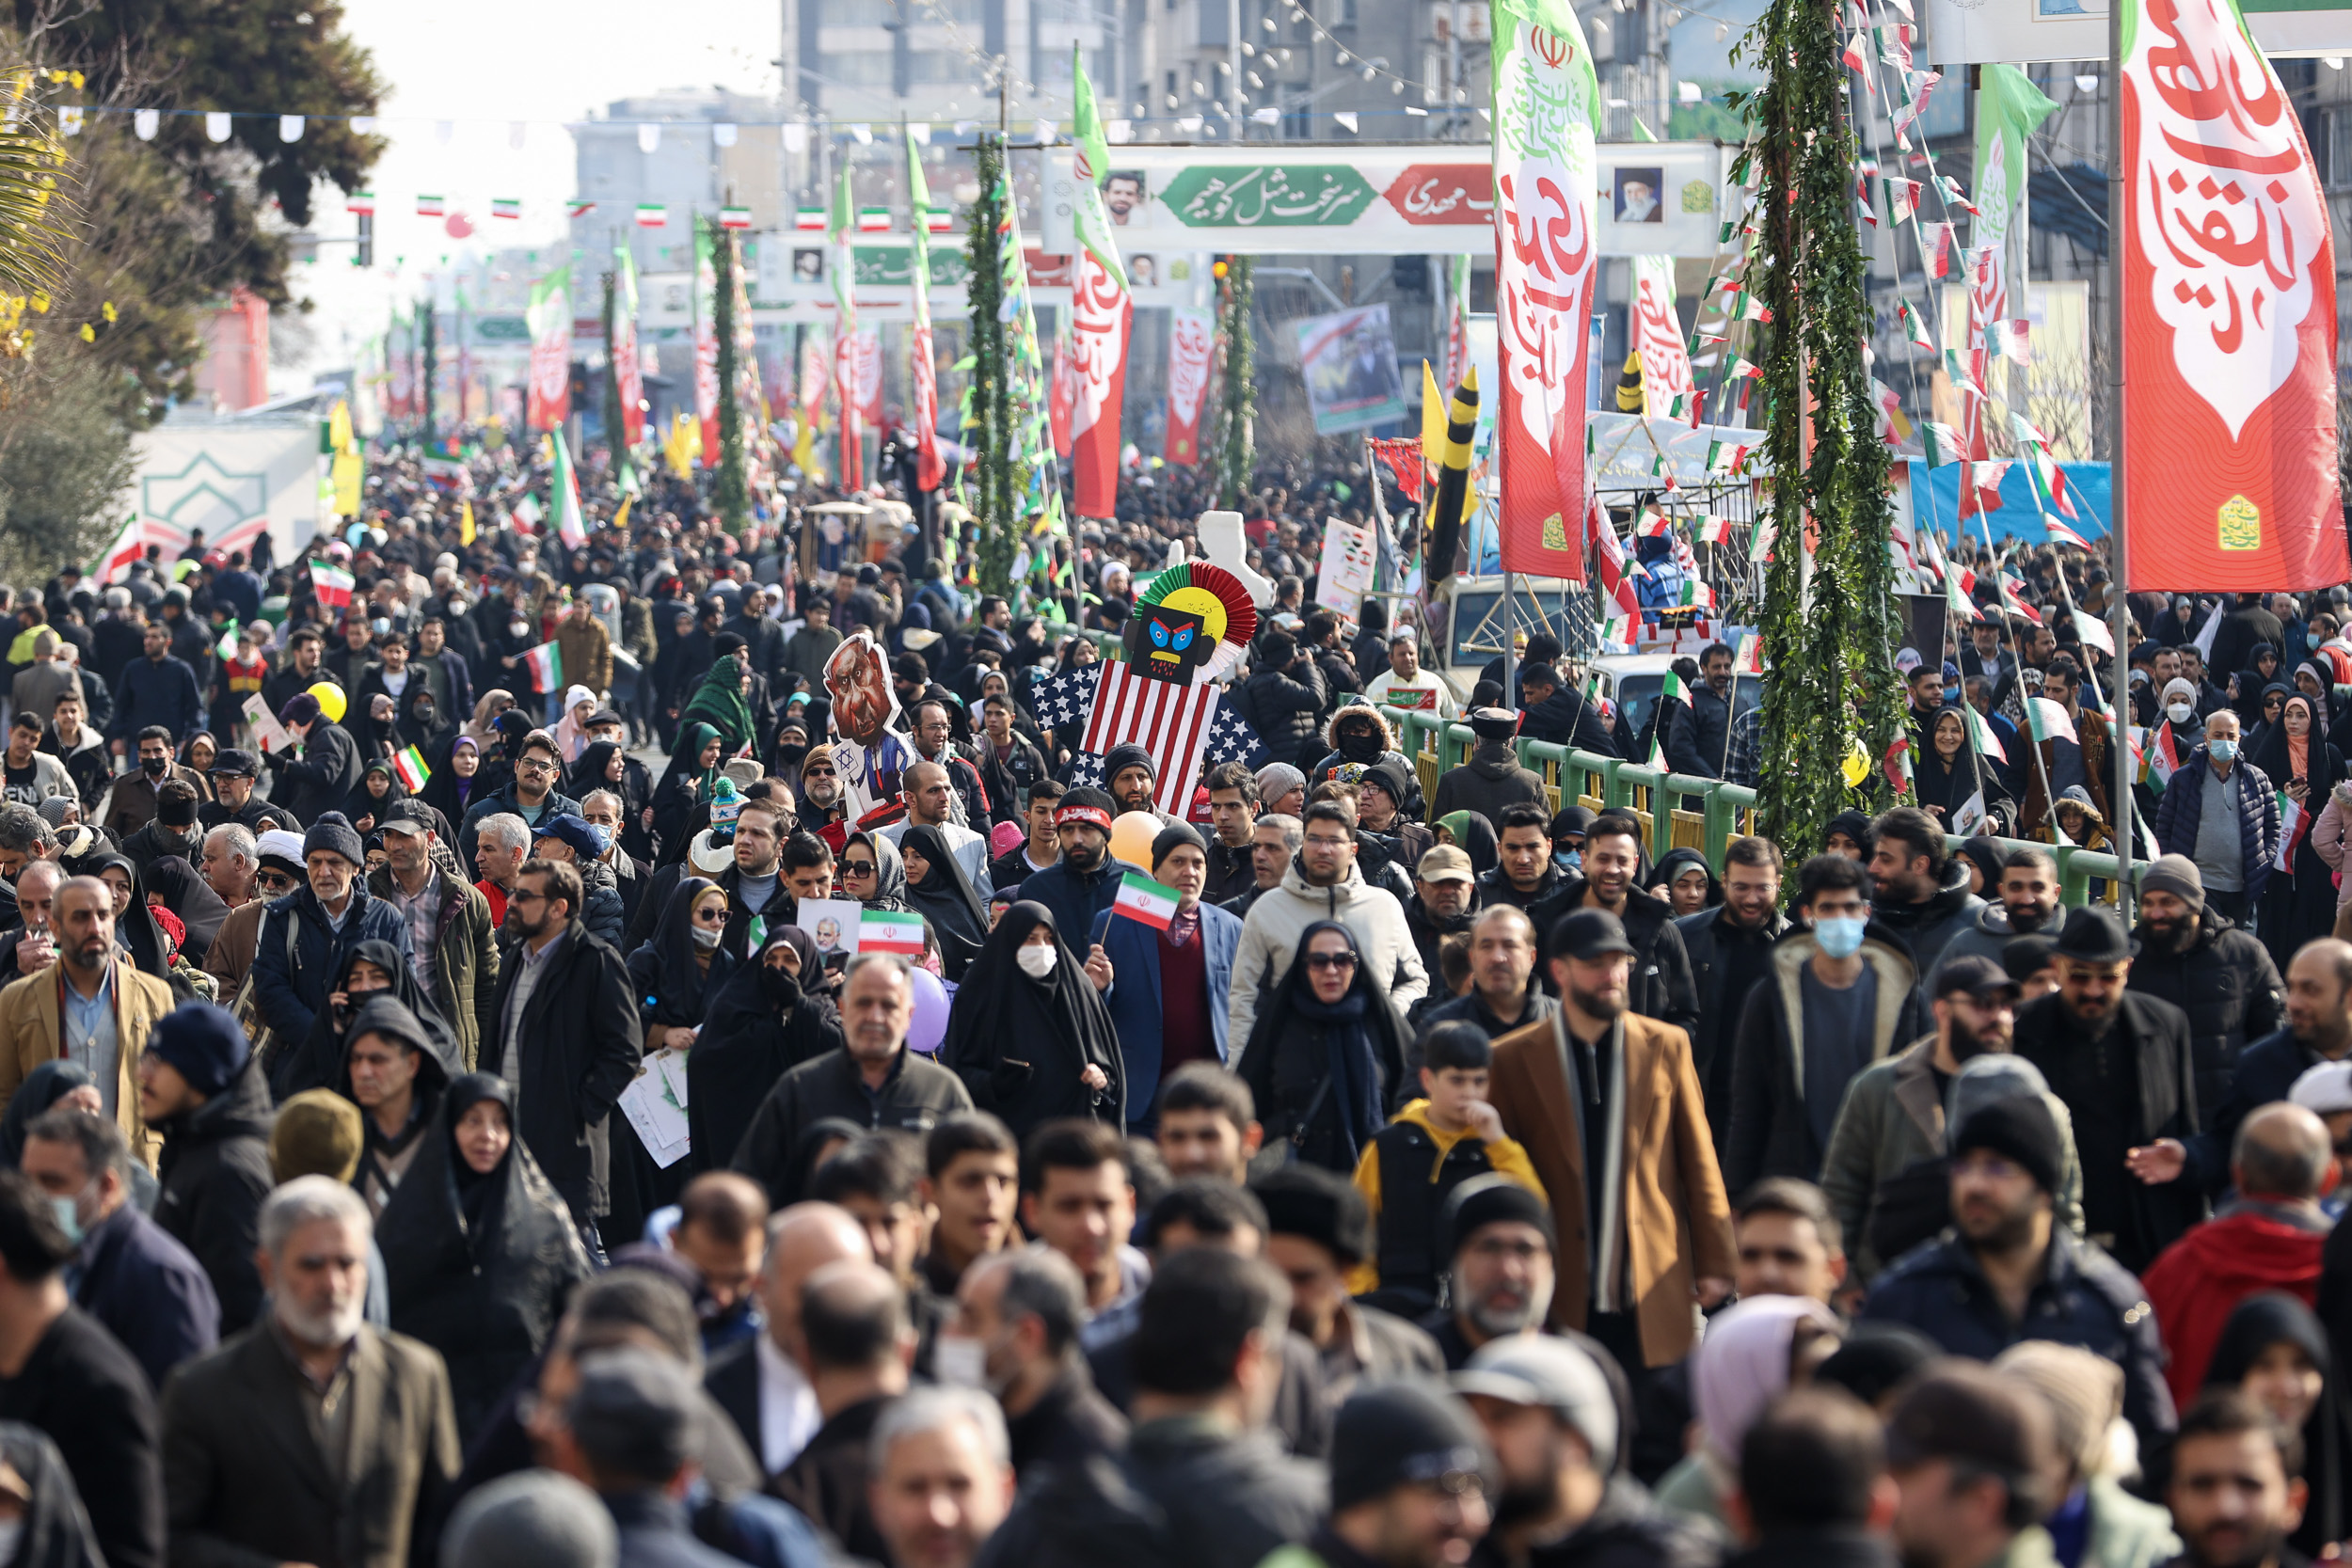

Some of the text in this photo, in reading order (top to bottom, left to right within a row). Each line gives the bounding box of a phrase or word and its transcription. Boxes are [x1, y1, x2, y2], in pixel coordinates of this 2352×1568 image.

[1233, 167, 1289, 226] مثل
[1270, 174, 1362, 223] سرسخت
[1403, 177, 1467, 218] مهدی
